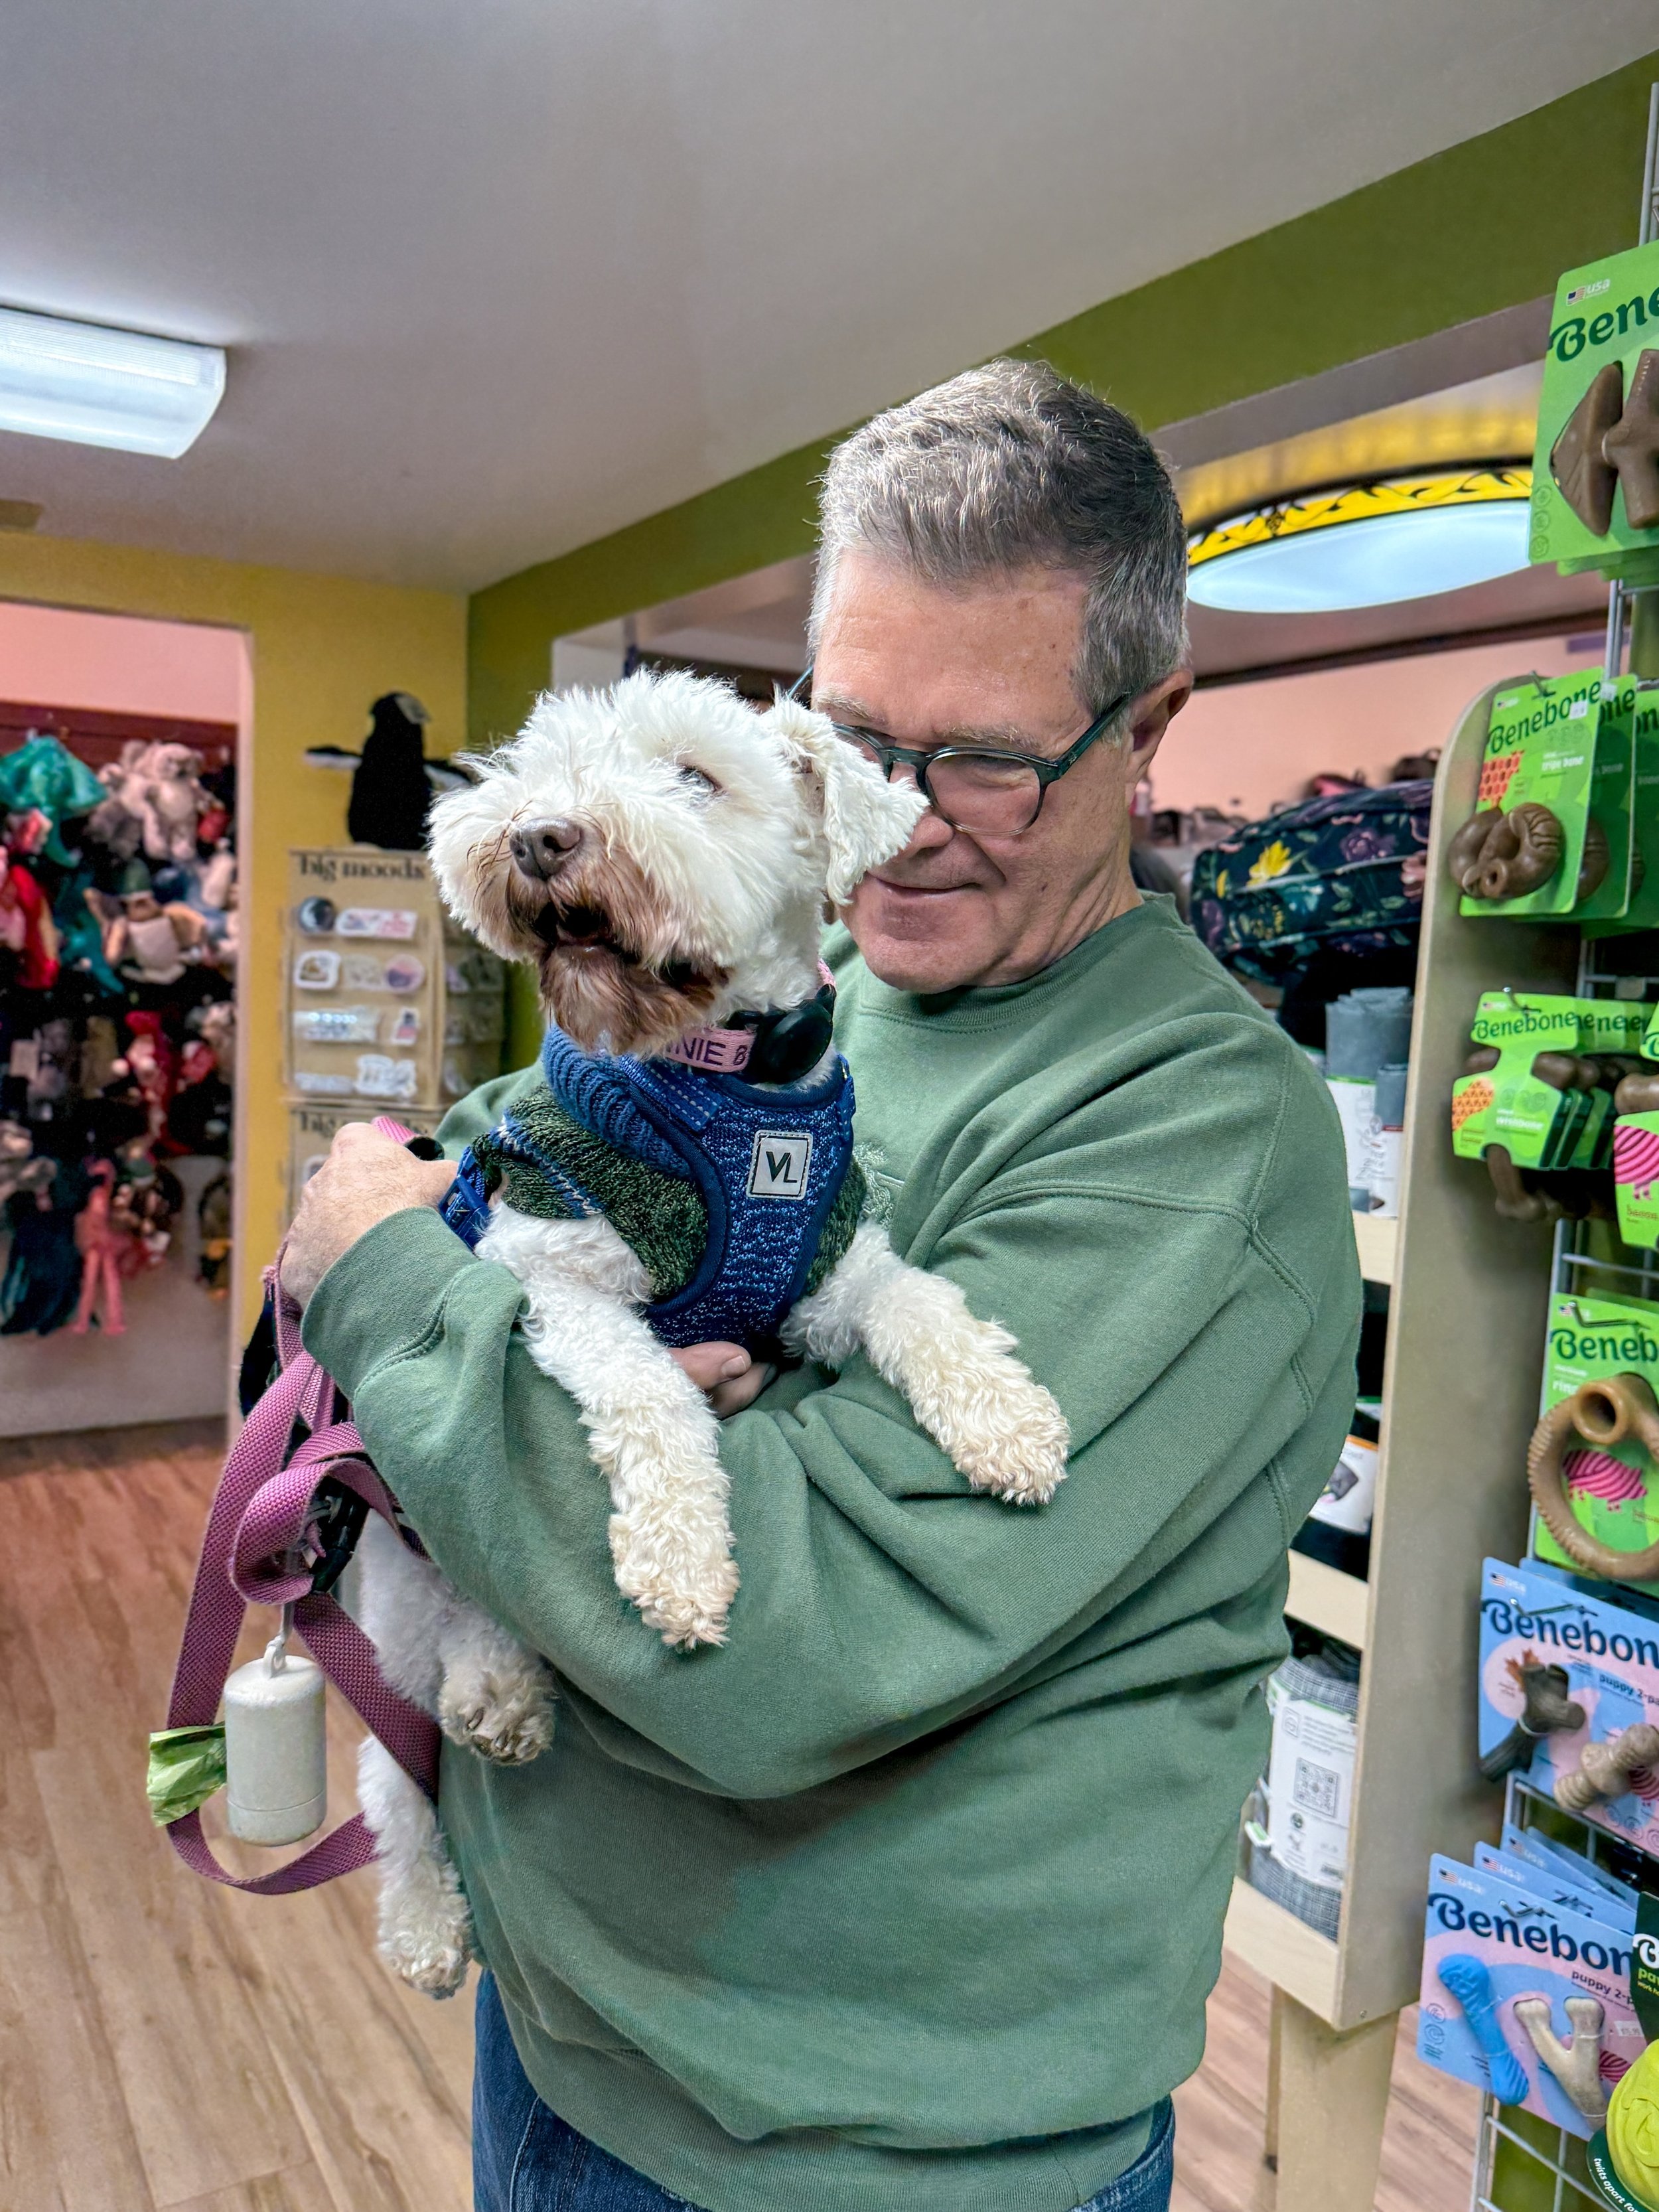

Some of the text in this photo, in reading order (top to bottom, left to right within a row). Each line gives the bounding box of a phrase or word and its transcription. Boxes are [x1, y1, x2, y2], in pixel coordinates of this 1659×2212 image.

[1586, 278, 1611, 294] usa
[1473, 1011, 1577, 1040] Benebone
[1572, 1970, 1611, 1995] puppy
[1593, 2158, 1607, 2180] twists
[1603, 2180, 1626, 2203] apart
